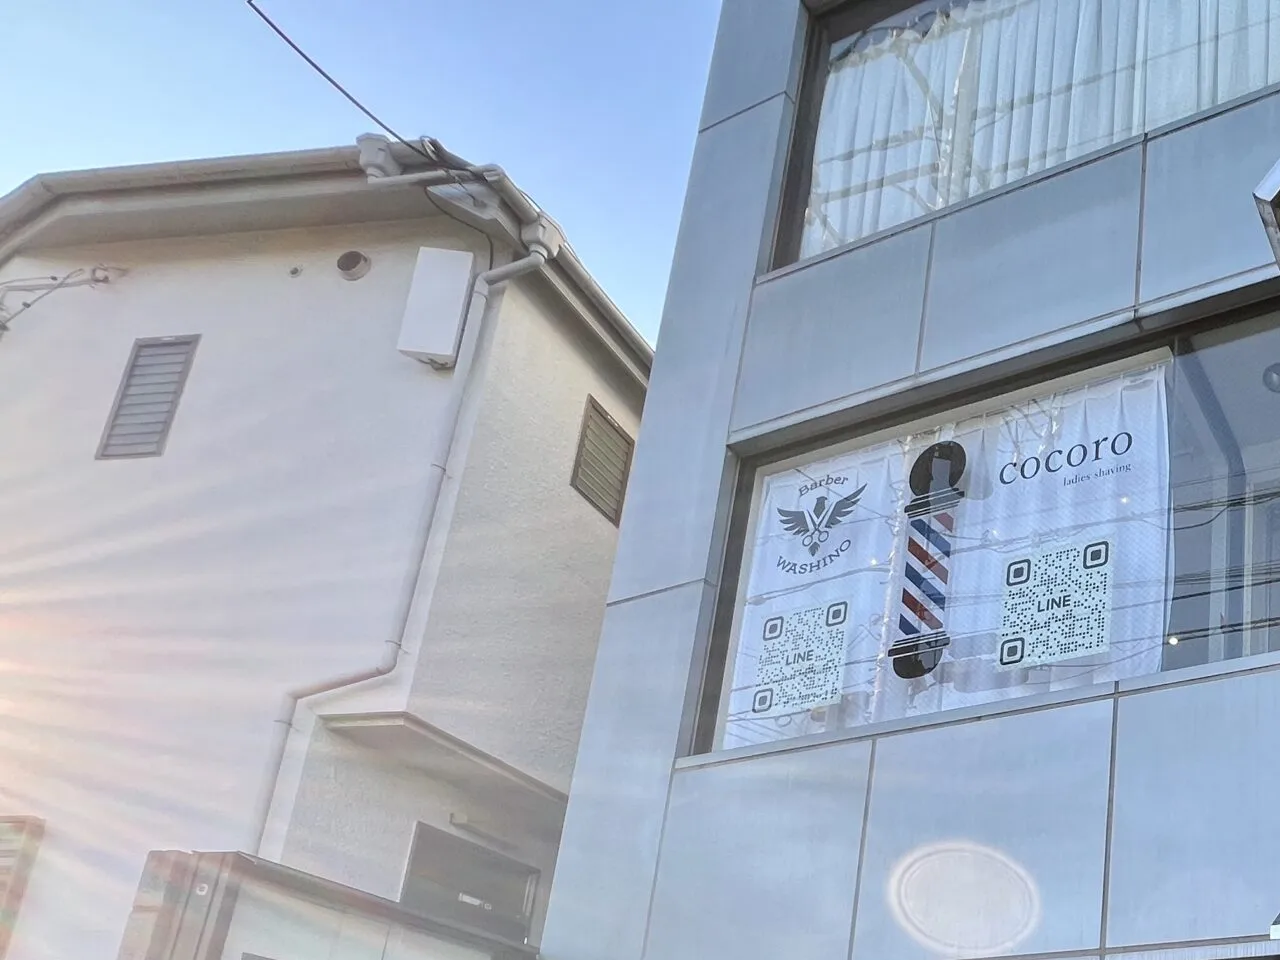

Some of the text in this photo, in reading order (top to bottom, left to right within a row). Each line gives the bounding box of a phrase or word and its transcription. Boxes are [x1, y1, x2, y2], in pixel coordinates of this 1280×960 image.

[999, 430, 1133, 485] cocoro
[798, 474, 849, 498] Barber
[1063, 461, 1132, 487] ladies shaving
[775, 538, 852, 575] WASHINO
[1037, 594, 1072, 613] LINE
[785, 649, 814, 666] LINE
